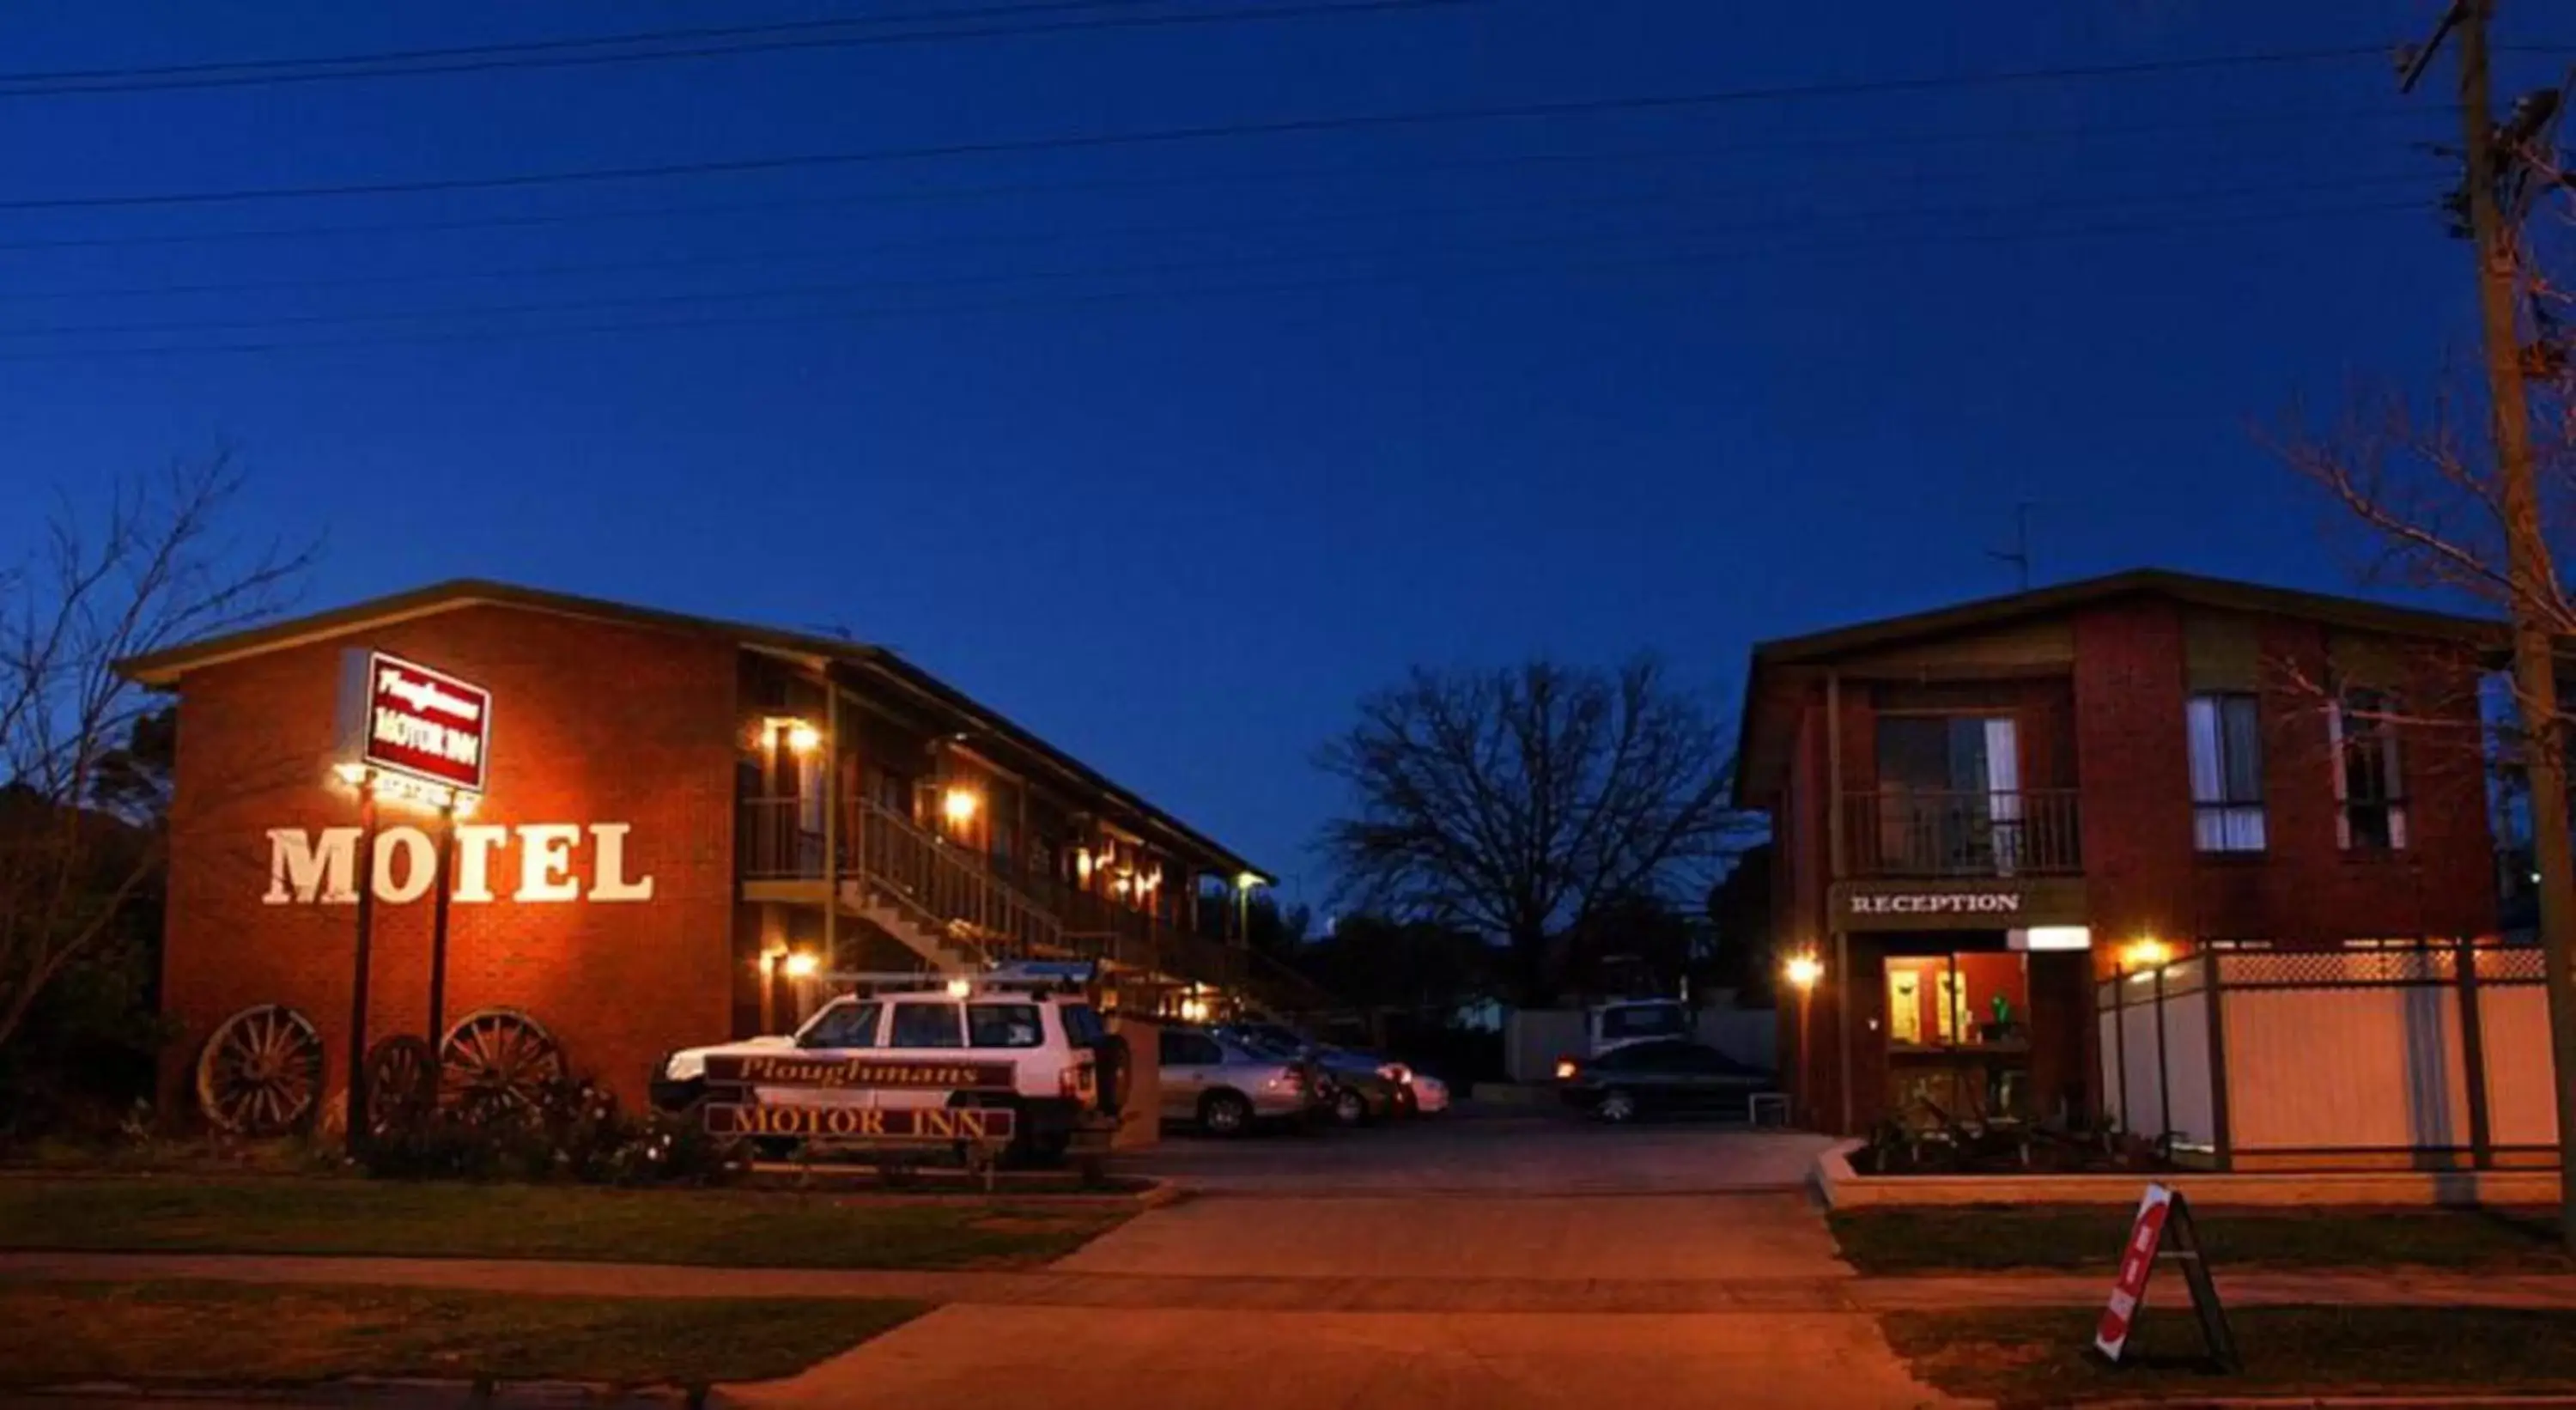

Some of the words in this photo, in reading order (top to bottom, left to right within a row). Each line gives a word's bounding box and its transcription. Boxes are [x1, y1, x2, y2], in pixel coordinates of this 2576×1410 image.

[374, 707, 446, 758] MOTOR
[262, 823, 653, 904] MOTEL
[1850, 894, 2020, 913] RECEPTION
[733, 1104, 885, 1135] MOTOR
[910, 1106, 987, 1139] INN
